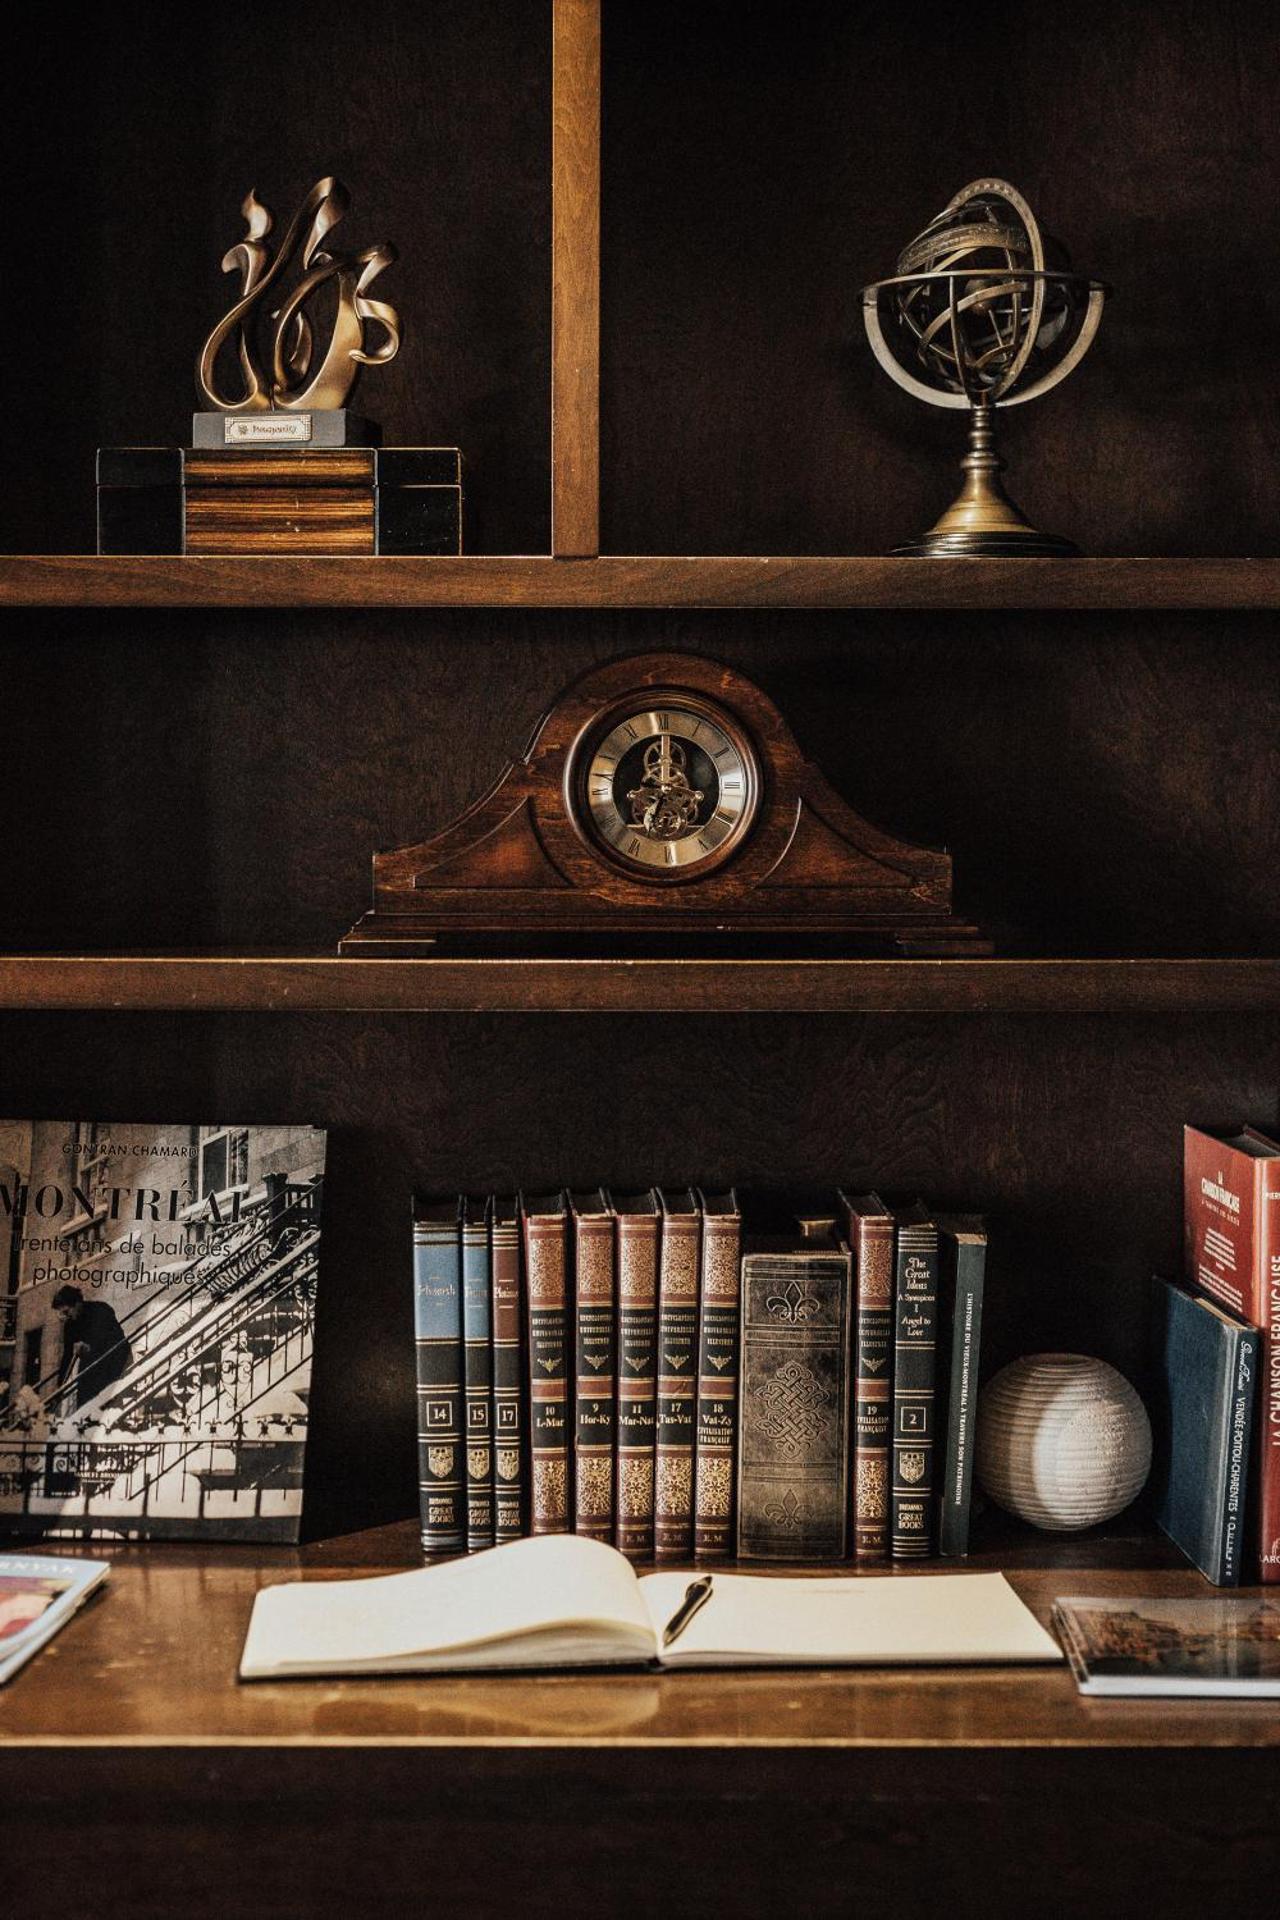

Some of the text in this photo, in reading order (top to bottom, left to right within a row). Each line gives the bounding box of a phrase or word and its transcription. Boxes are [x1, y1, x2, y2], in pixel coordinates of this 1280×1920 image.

[62, 1143, 198, 1158] GONTRAN CHAMARD
[77, 1238, 112, 1253] ans
[119, 1232, 144, 1254] de
[152, 1233, 231, 1257] balades
[908, 1257, 927, 1268] The
[33, 1259, 205, 1290] photographiques
[905, 1268, 931, 1279] Great
[906, 1279, 928, 1289] Ideas
[965, 1333, 972, 1344] DU
[545, 1406, 555, 1415] 10
[592, 1403, 599, 1412] 9
[632, 1405, 642, 1414] 11
[671, 1403, 681, 1412] 17
[713, 1404, 724, 1412] 18
[867, 1406, 877, 1415] 19
[433, 1408, 447, 1420] 14
[472, 1409, 485, 1420] 15
[502, 1410, 514, 1421] 17
[909, 1414, 917, 1424] 2
[1228, 1397, 1246, 1512] VENDÉE-POITOU-CHARENTES
